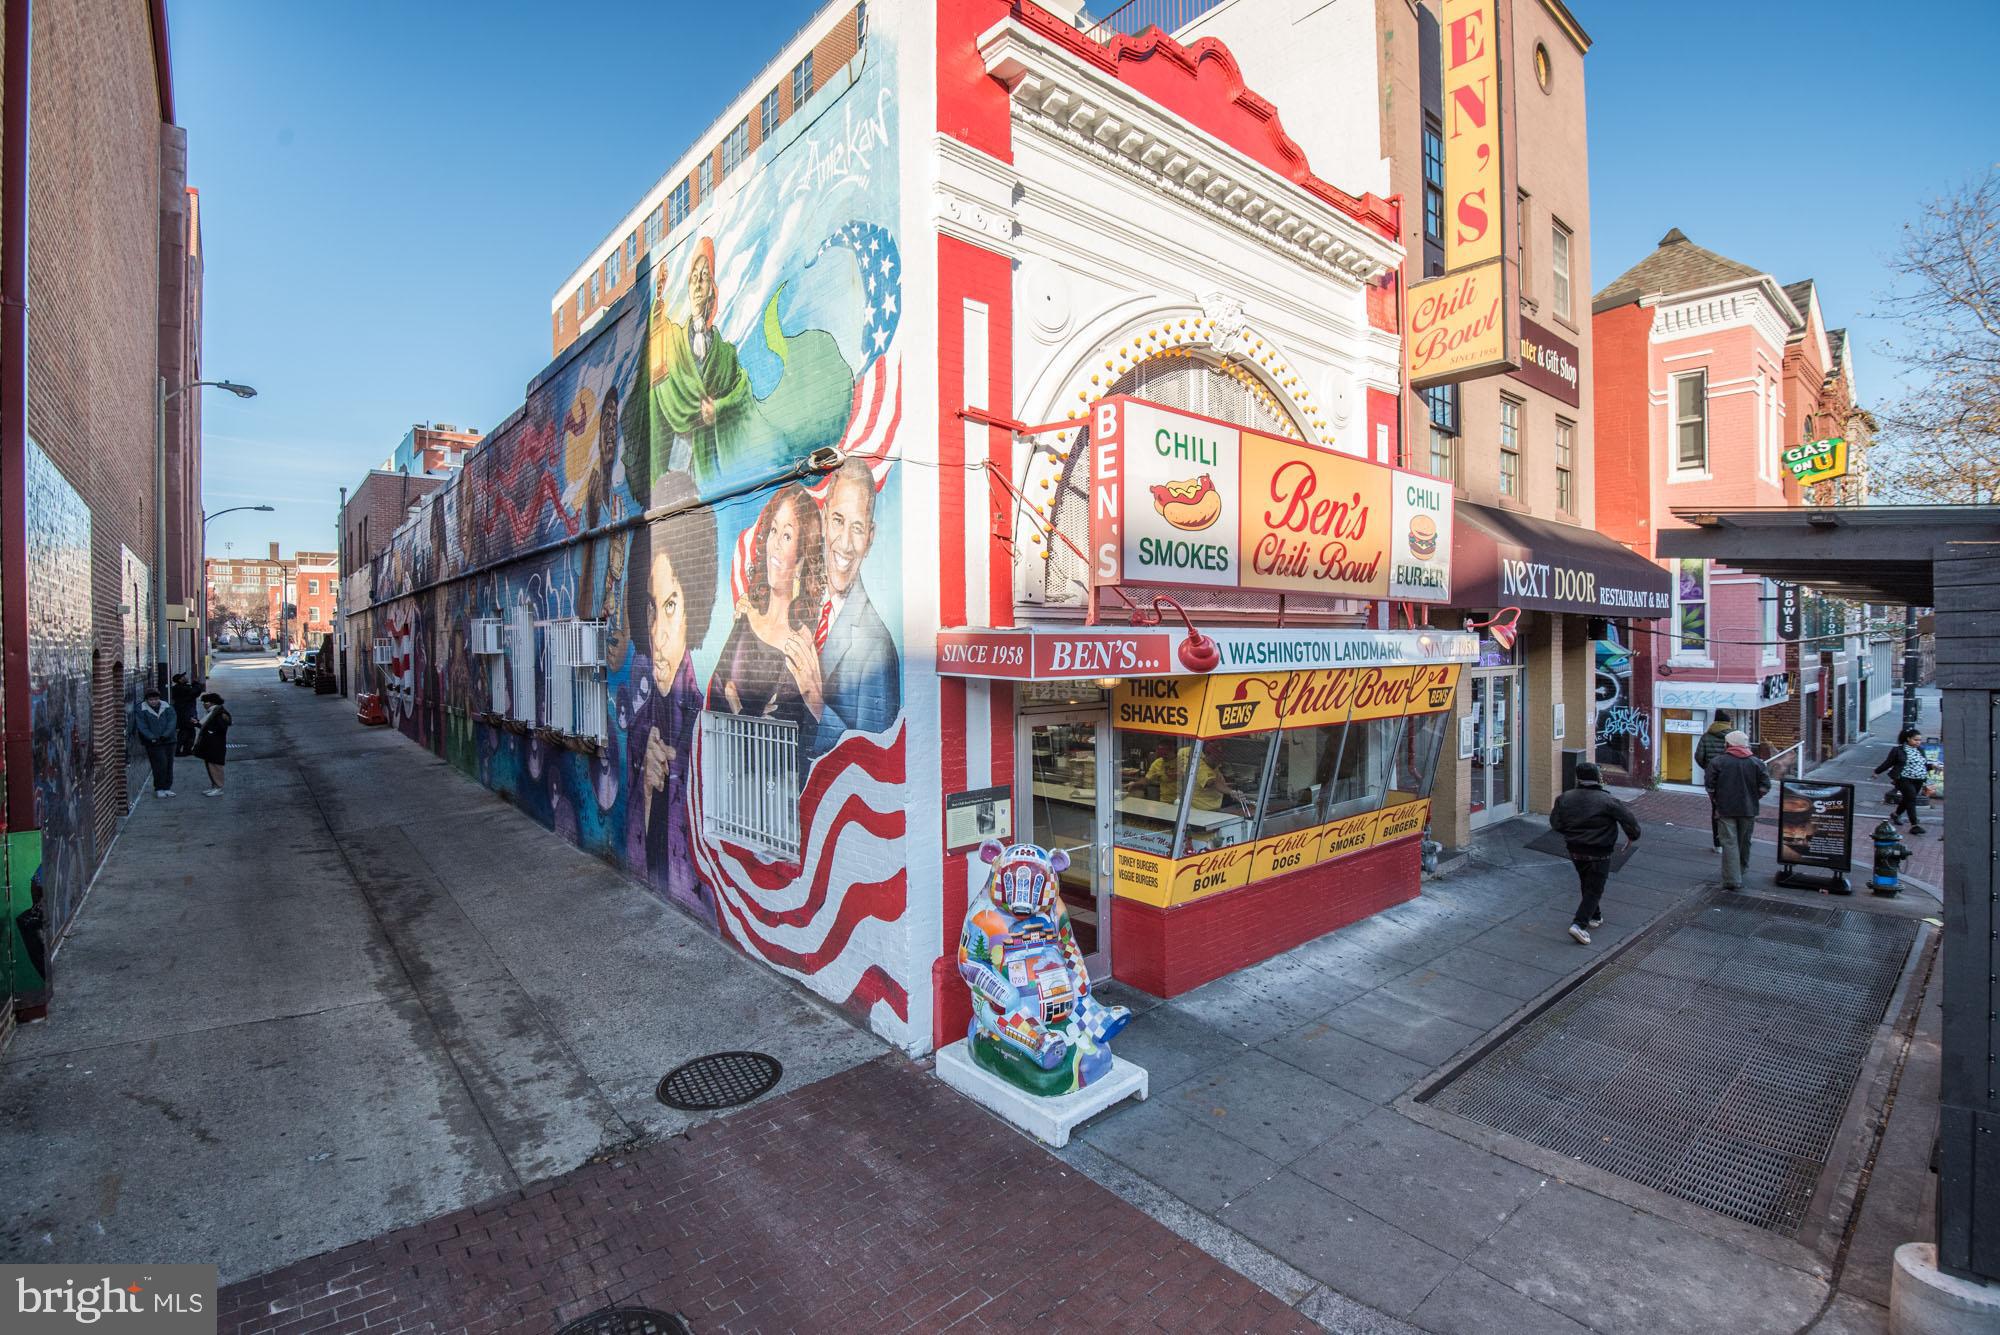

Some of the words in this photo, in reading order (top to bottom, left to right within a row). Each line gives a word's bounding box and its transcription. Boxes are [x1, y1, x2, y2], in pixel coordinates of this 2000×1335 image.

[1447, 0, 1490, 247] EN'S
[1412, 277, 1477, 333] Chili
[1411, 298, 1499, 370] Bowl
[1450, 351, 1476, 364] SINCE
[1520, 338, 1536, 363] nter
[1538, 345, 1545, 367] &
[1545, 349, 1559, 375] Gift
[1560, 356, 1577, 389] Shop
[1154, 428, 1218, 466] CHILI
[1786, 440, 1831, 461] GAS
[1792, 460, 1813, 473] ON
[1813, 452, 1834, 470] U
[1097, 403, 1118, 578] BEN'S
[1264, 460, 1369, 540] Ben's
[1406, 486, 1440, 511] CHILI
[1138, 536, 1229, 572] SMOKES
[1253, 532, 1309, 579] Chili
[1314, 541, 1383, 584] Bowl
[1396, 564, 1444, 588] BURGER
[1554, 567, 1596, 603] DOOR
[1600, 587, 1648, 608] RESTAURANT
[1648, 592, 1655, 608] &
[1655, 593, 1670, 609] BAR
[1783, 590, 1796, 633] BOWLS
[942, 644, 988, 664] SINCE
[991, 645, 1024, 665] 1958
[1049, 640, 1159, 671] BEN'S...
[1227, 641, 1331, 664] WASHINGTON
[1335, 640, 1403, 662] LANDMARK
[1424, 641, 1455, 658] SINCE
[1128, 679, 1179, 699] THICK
[1273, 668, 1357, 718] Chili
[1354, 665, 1429, 708] Bowl
[1430, 689, 1450, 705] BEN'S
[1120, 703, 1189, 726] SHAKES
[1221, 704, 1253, 726] BEN'S
[1391, 803, 1417, 823] Chili
[1337, 817, 1368, 838] Chili
[1383, 818, 1418, 838] BURGERS
[1273, 832, 1307, 856] Chili
[1329, 833, 1366, 853] SMOKES
[1118, 855, 1136, 868] TURKEY
[1136, 859, 1159, 874] BURGERS
[1196, 850, 1238, 876] Chili
[1272, 852, 1301, 871] DOGS
[1118, 870, 1136, 883] VEGGIE
[1135, 873, 1159, 889] BURGERS
[1193, 871, 1227, 892] BOWL
